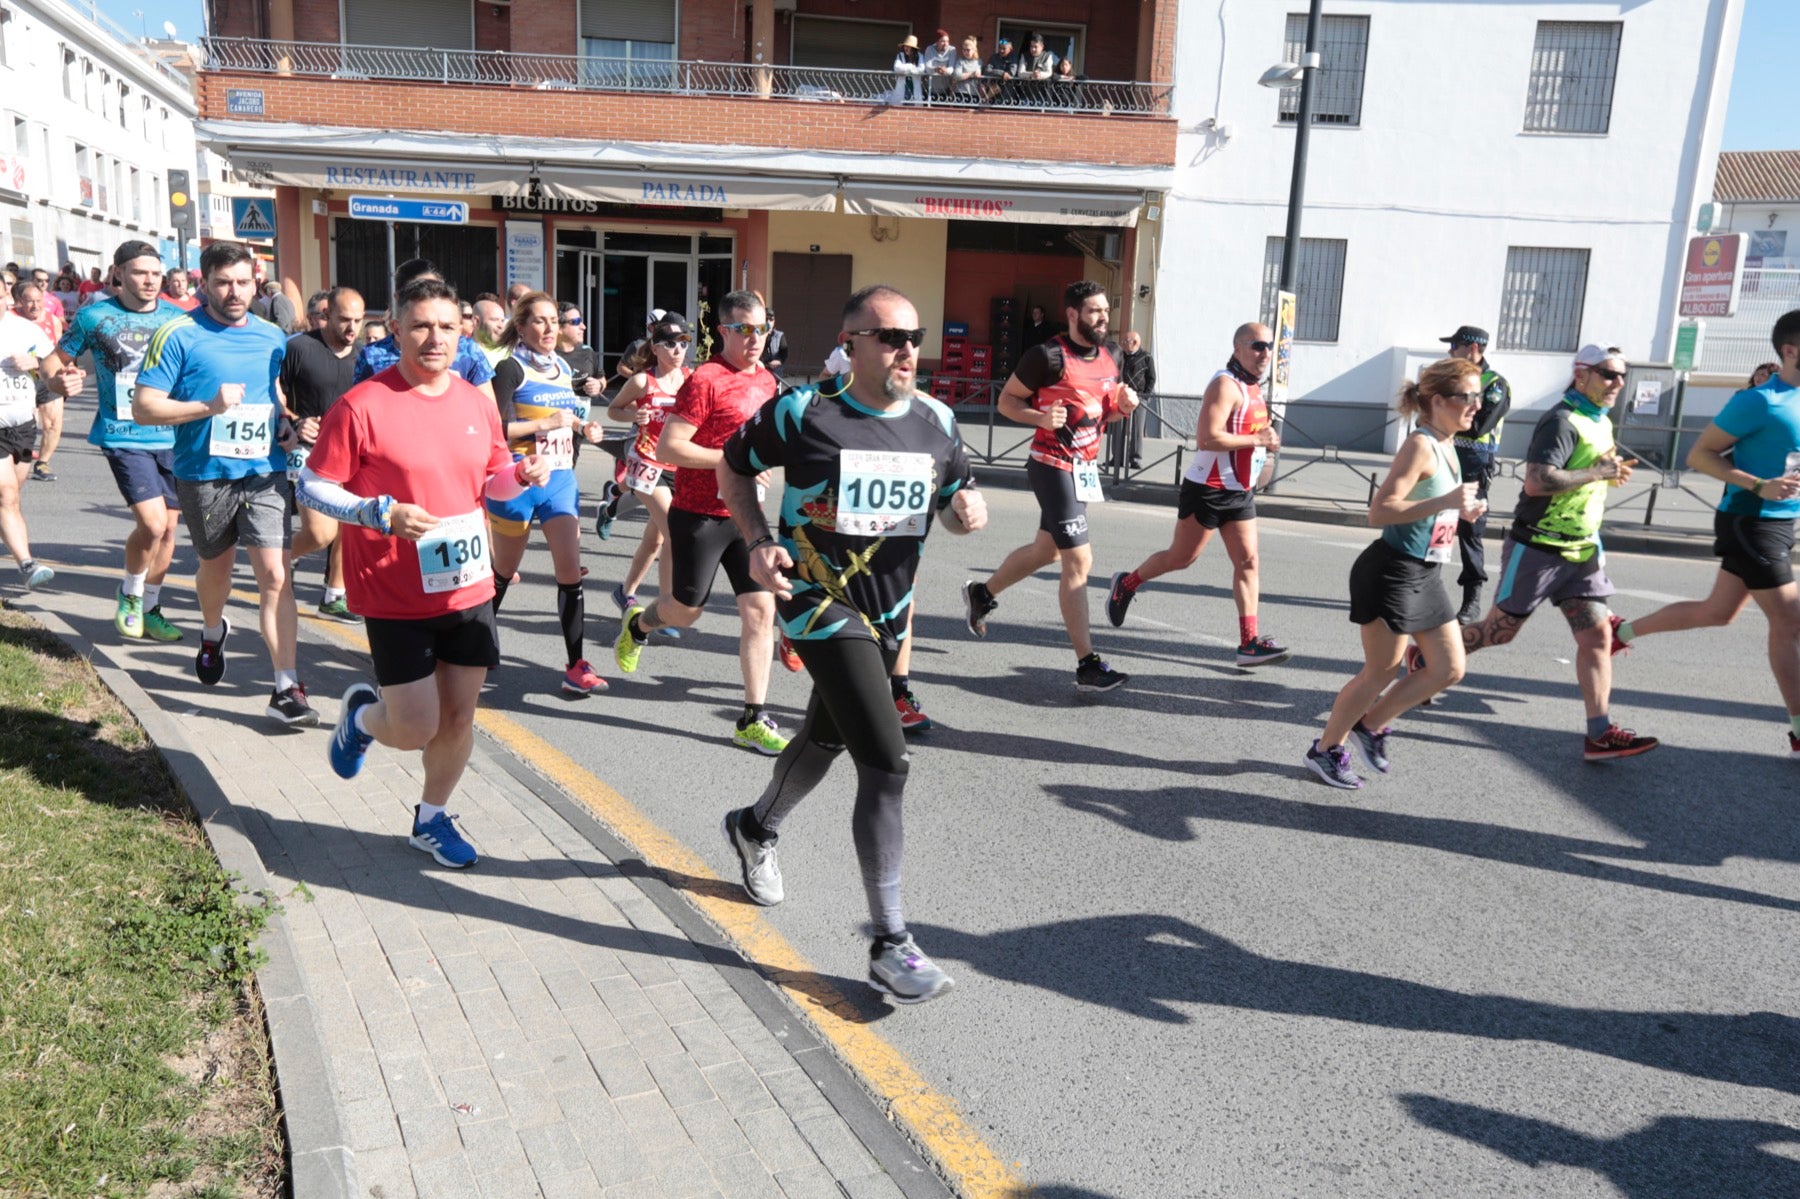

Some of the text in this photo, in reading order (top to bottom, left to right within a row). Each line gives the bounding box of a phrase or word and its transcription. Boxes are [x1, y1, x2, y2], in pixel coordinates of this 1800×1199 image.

[326, 166, 477, 190] RESTAURANTE
[642, 181, 727, 202] PARADA
[352, 202, 399, 215] Granada
[502, 195, 598, 213] BICHITOS
[1686, 270, 1733, 284] Gran apertura
[1682, 302, 1727, 314] ALBOLOTE
[3, 376, 28, 389] 162
[226, 421, 266, 441] 154
[540, 438, 571, 455] 2110
[847, 478, 926, 510] 1058
[435, 535, 482, 568] 130
